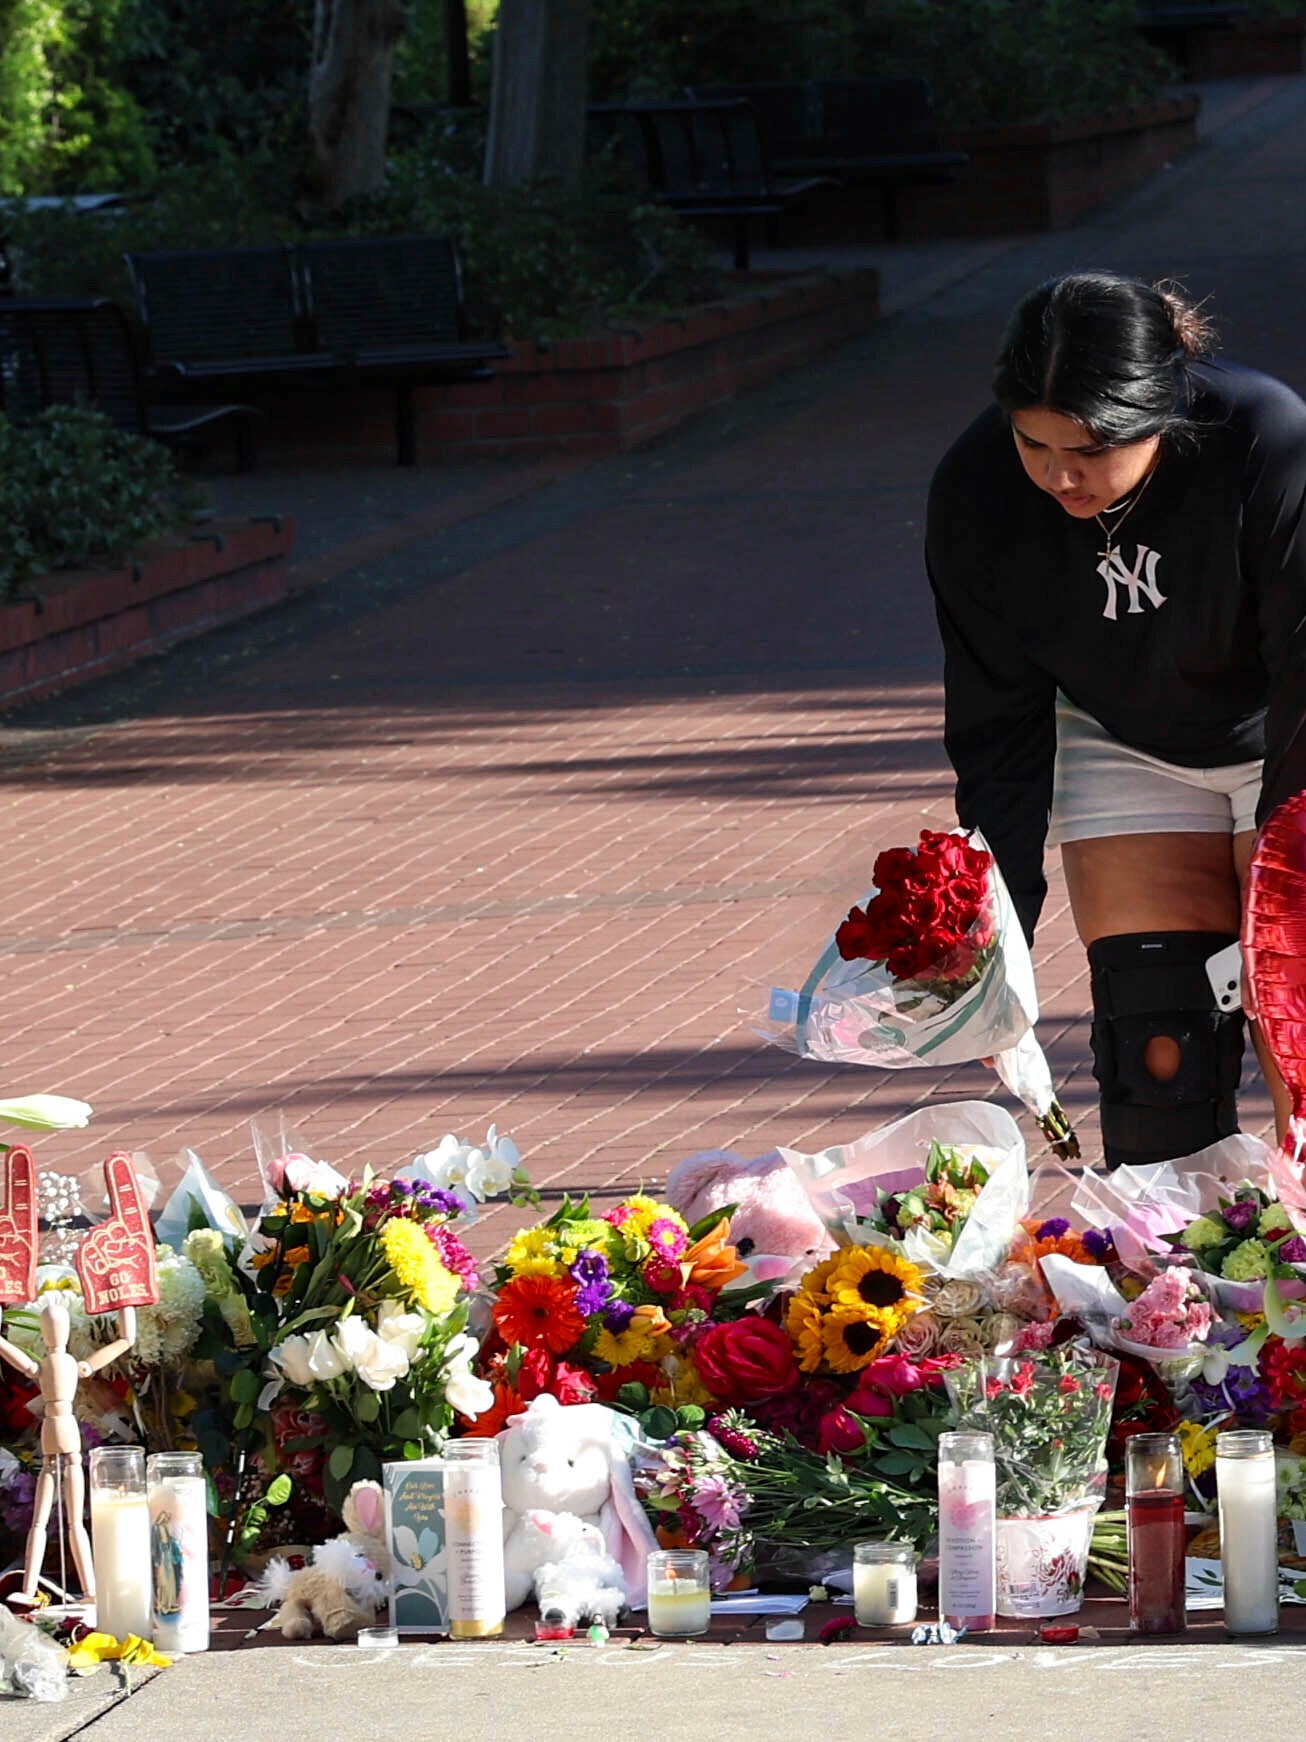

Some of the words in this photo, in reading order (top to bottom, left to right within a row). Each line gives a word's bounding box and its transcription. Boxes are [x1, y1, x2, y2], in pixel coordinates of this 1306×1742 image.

[1096, 543, 1168, 621] NY
[109, 1270, 131, 1286] GO
[97, 1283, 150, 1306] NOLES
